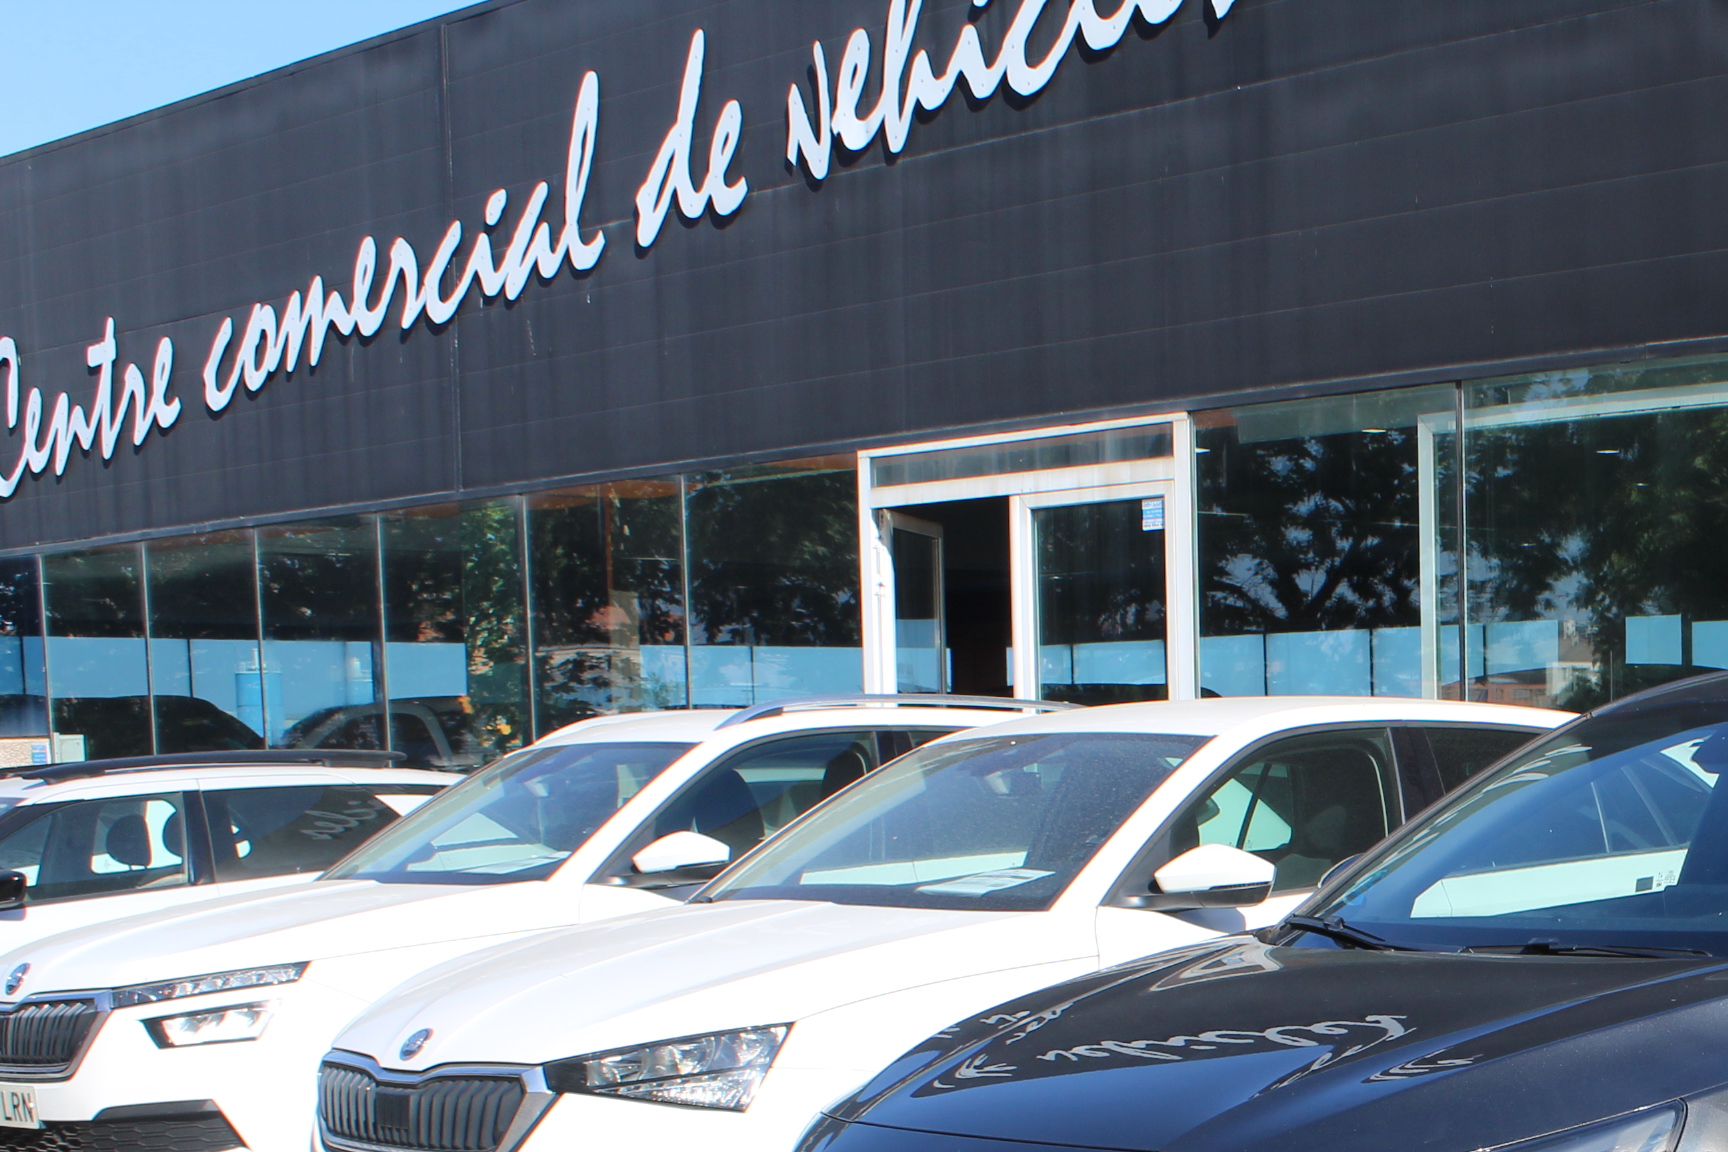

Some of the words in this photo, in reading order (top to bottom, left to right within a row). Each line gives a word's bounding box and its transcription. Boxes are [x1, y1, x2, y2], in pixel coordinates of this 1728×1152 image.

[0, 317, 181, 498] Centre
[203, 70, 604, 411] comercial
[636, 29, 748, 247] de
[787, 0, 1236, 180] vehic
[1, 1091, 35, 1122] LRN
